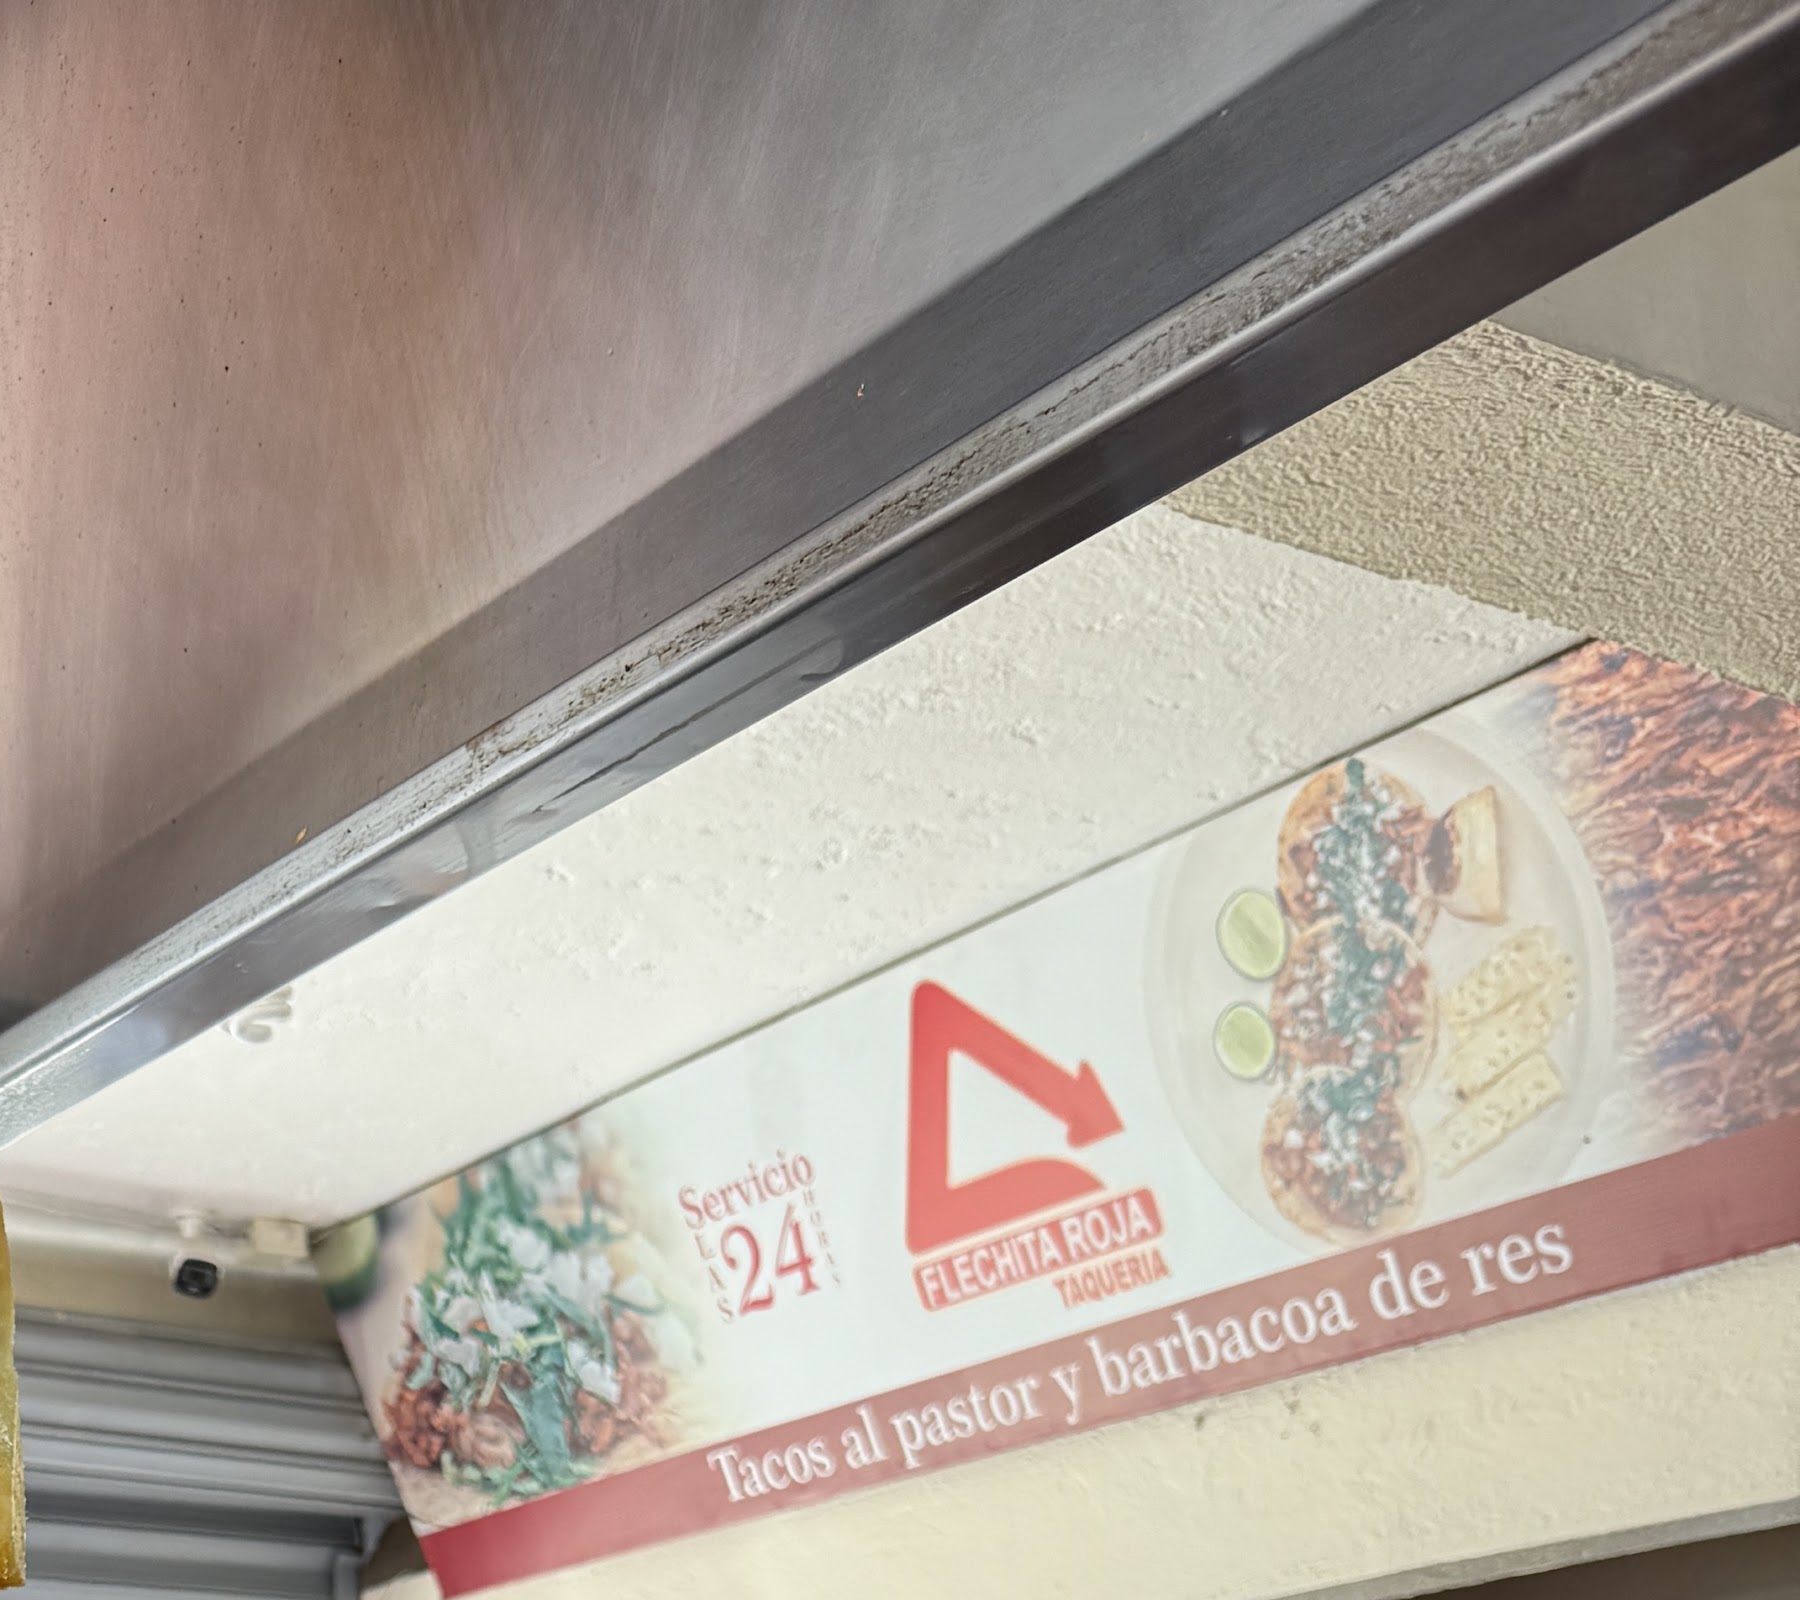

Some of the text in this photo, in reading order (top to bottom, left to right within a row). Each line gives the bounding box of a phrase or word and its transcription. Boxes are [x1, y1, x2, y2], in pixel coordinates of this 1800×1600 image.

[678, 1148, 816, 1230] Servicio
[720, 1201, 821, 1317] 24
[920, 1195, 1154, 1308] FLECHITA ROJA
[707, 1223, 1573, 1502] Tacos al pastor y barbacoa de res
